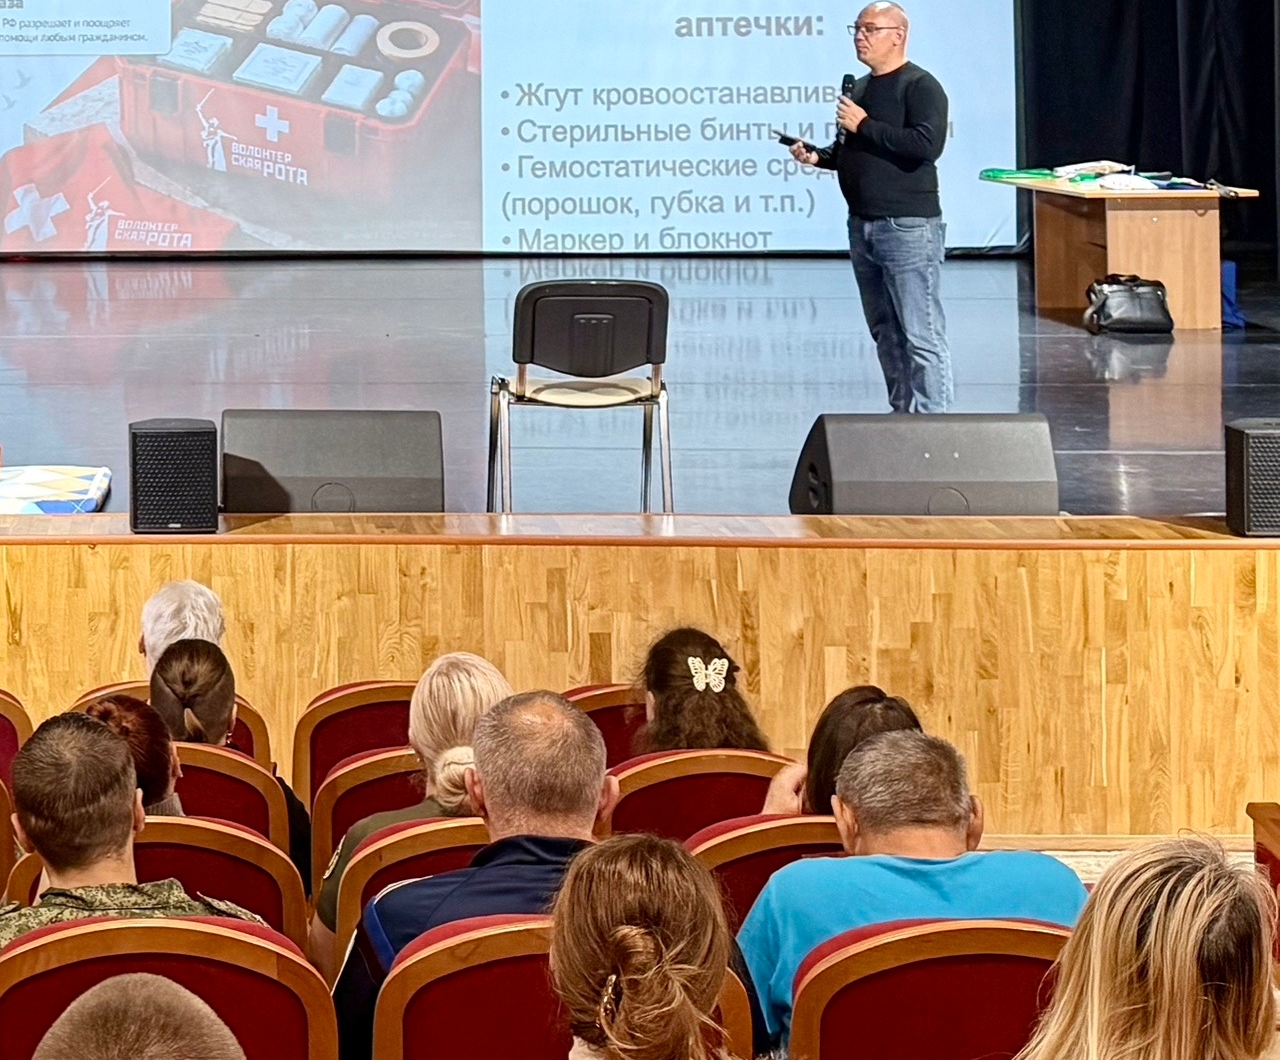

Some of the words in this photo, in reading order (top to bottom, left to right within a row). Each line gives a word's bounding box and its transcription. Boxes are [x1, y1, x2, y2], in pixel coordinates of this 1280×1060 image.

[3, 17, 17, 28] РФ
[19, 19, 71, 31] разрешает
[73, 20, 81, 28] и
[82, 19, 130, 30] поощряет
[675, 16, 823, 37] аптечки:
[41, 32, 76, 43] любым
[515, 83, 583, 112] Жгут
[593, 83, 841, 109] кровоостанавлив
[517, 119, 691, 148] Стерильные
[799, 123, 814, 139] и
[232, 142, 292, 164] ВОЛОНТЕР
[232, 154, 261, 172] СКАЯ
[263, 161, 308, 186] РОТА
[519, 155, 757, 178] Гемостатические
[767, 158, 836, 182] сре
[502, 192, 639, 221] (порошок,
[651, 190, 724, 219] губка
[735, 195, 750, 212] и
[759, 189, 815, 218] т.п.)
[117, 220, 178, 232] ВОЛОНТЕР
[115, 229, 146, 241] СКАЯ
[146, 231, 192, 247] РОТА
[518, 228, 624, 252] Маркер
[634, 233, 649, 249] и
[660, 227, 772, 248] блокнот
